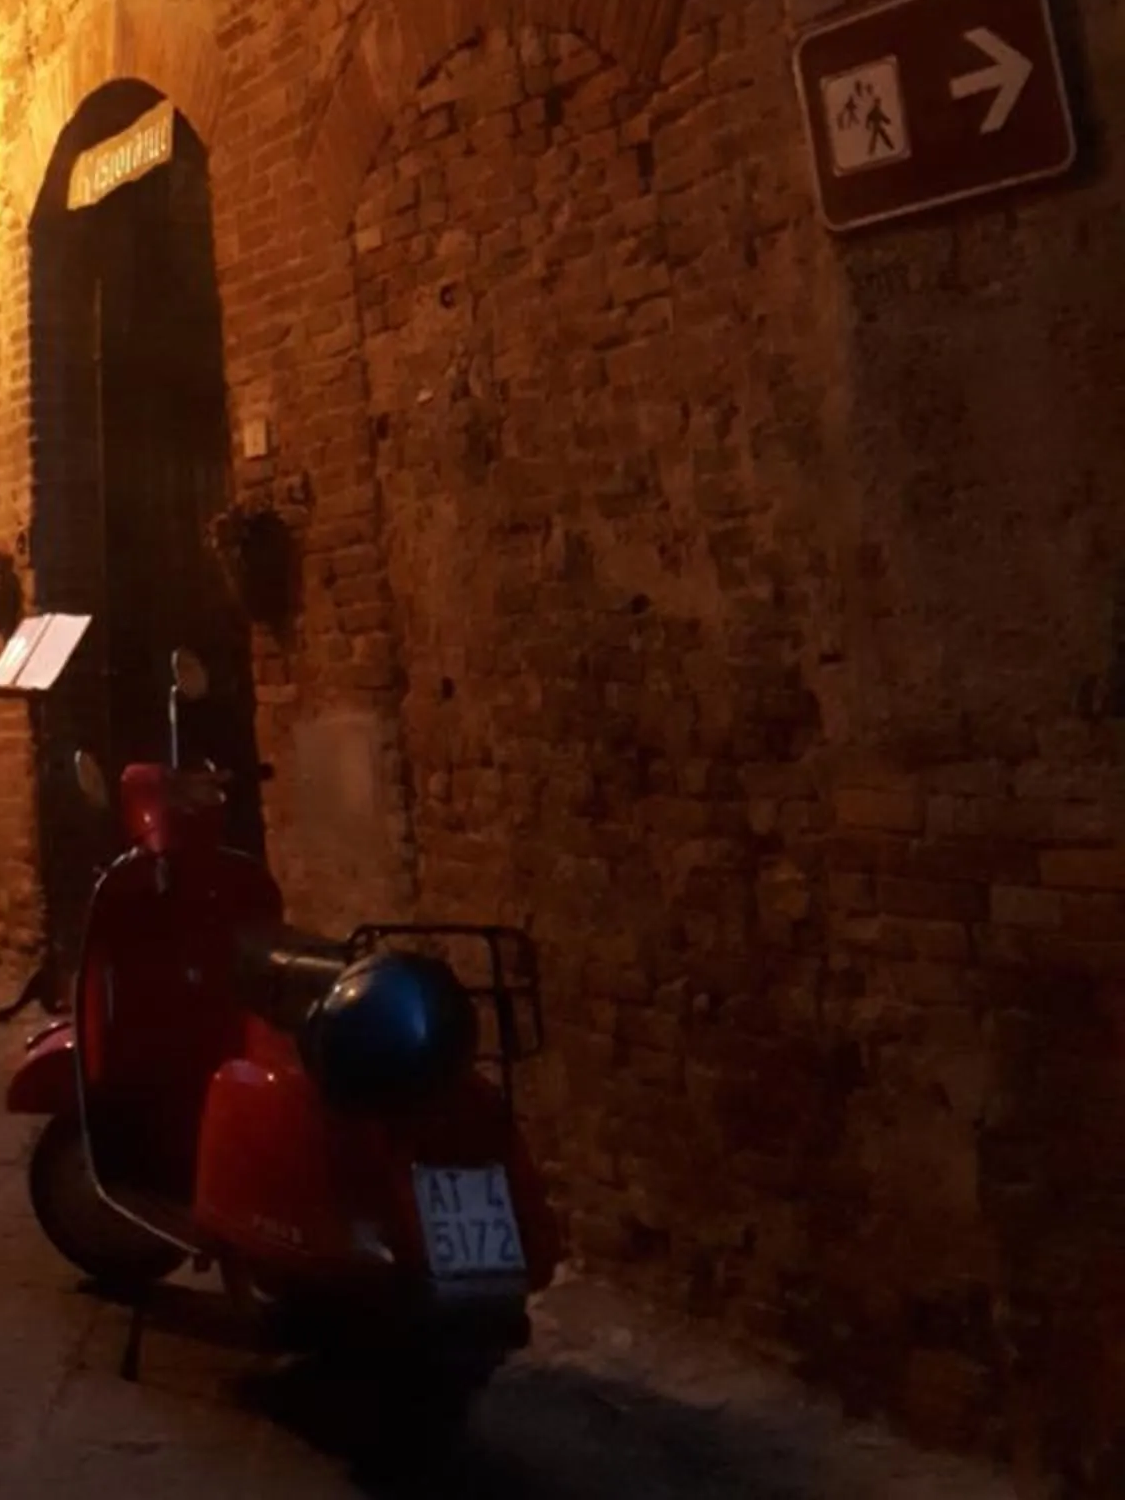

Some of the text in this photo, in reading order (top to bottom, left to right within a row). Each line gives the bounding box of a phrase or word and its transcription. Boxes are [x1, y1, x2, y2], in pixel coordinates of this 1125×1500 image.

[430, 1171, 505, 1213] AT 4
[434, 1219, 518, 1264] 5172
